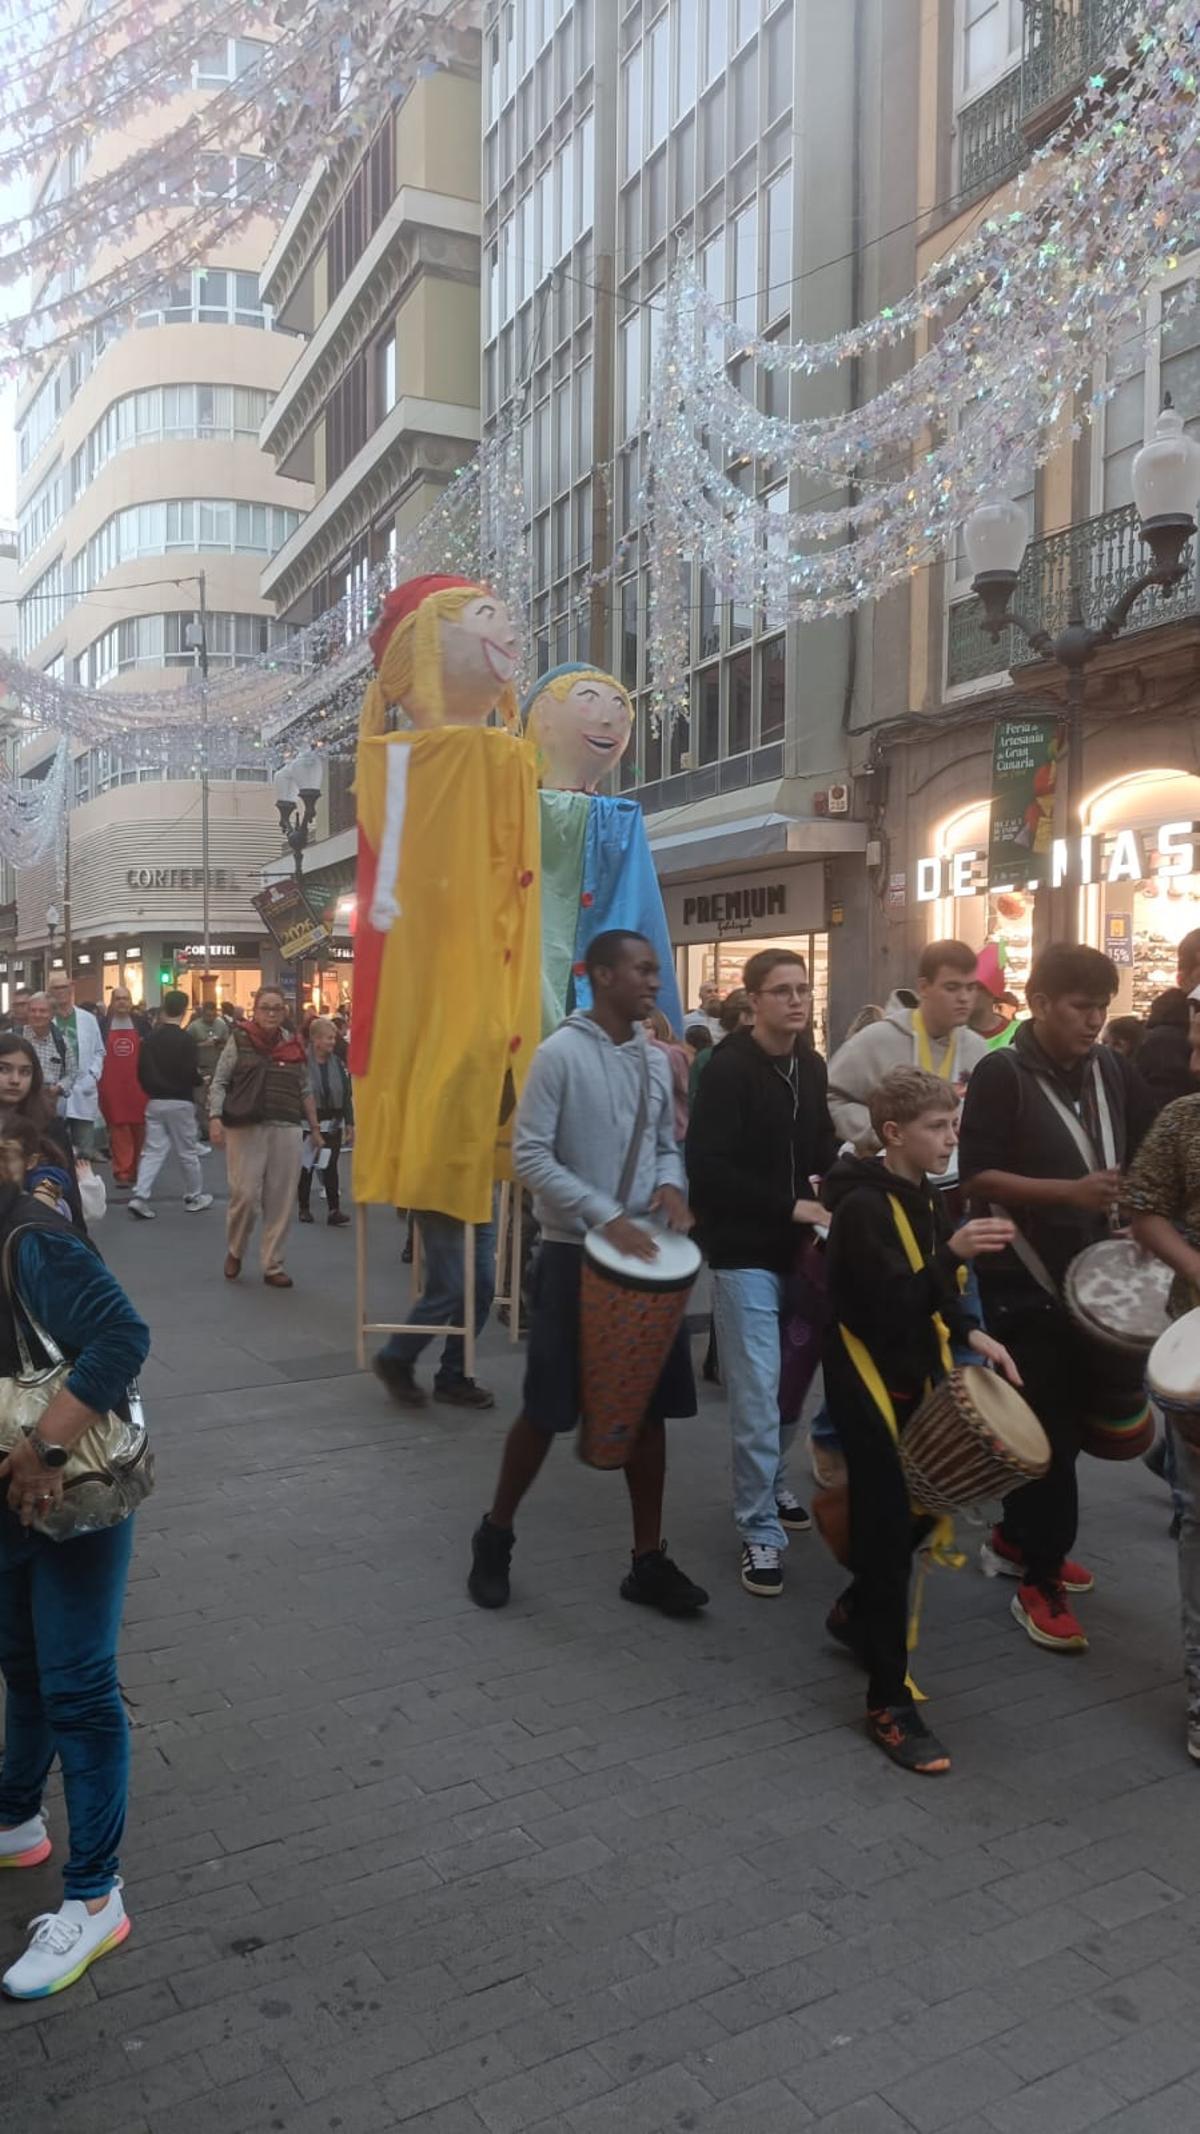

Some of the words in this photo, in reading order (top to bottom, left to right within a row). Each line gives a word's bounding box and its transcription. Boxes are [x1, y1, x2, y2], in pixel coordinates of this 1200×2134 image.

[997, 756, 1035, 771] Canaria
[917, 821, 1195, 901] DEMAS
[683, 884, 787, 926] PREMIUM
